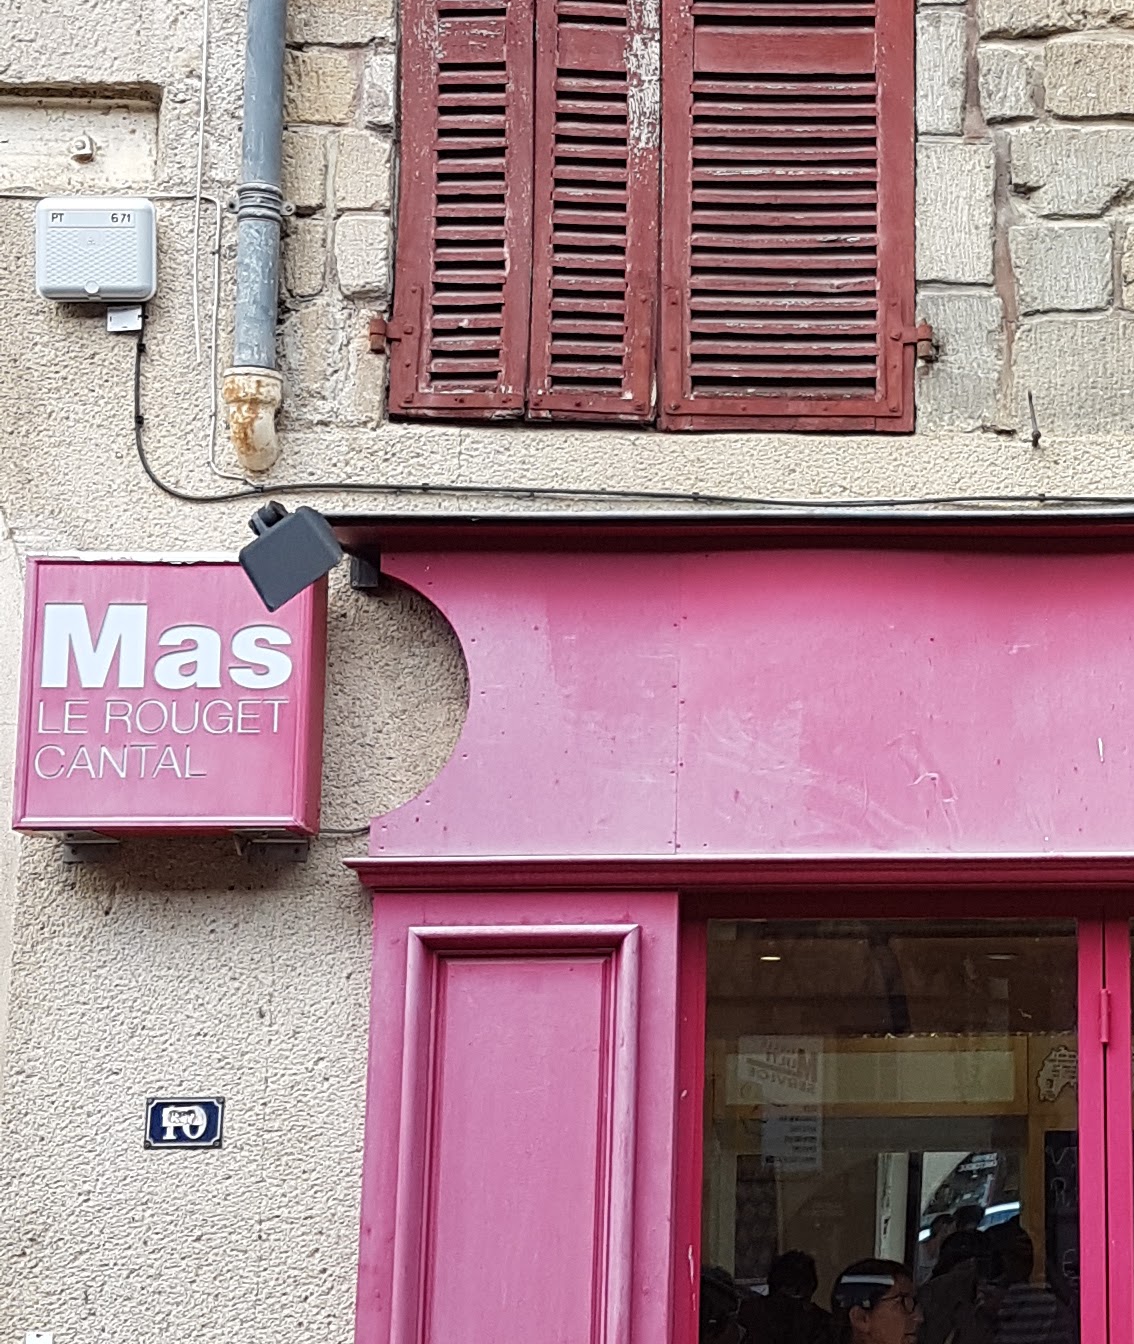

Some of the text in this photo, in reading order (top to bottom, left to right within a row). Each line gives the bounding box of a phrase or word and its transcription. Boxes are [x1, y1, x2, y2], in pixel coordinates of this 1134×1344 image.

[51, 212, 65, 223] PT
[40, 602, 293, 690] Mas
[37, 699, 289, 735] LE ROUGET
[34, 744, 208, 779] CANTAL
